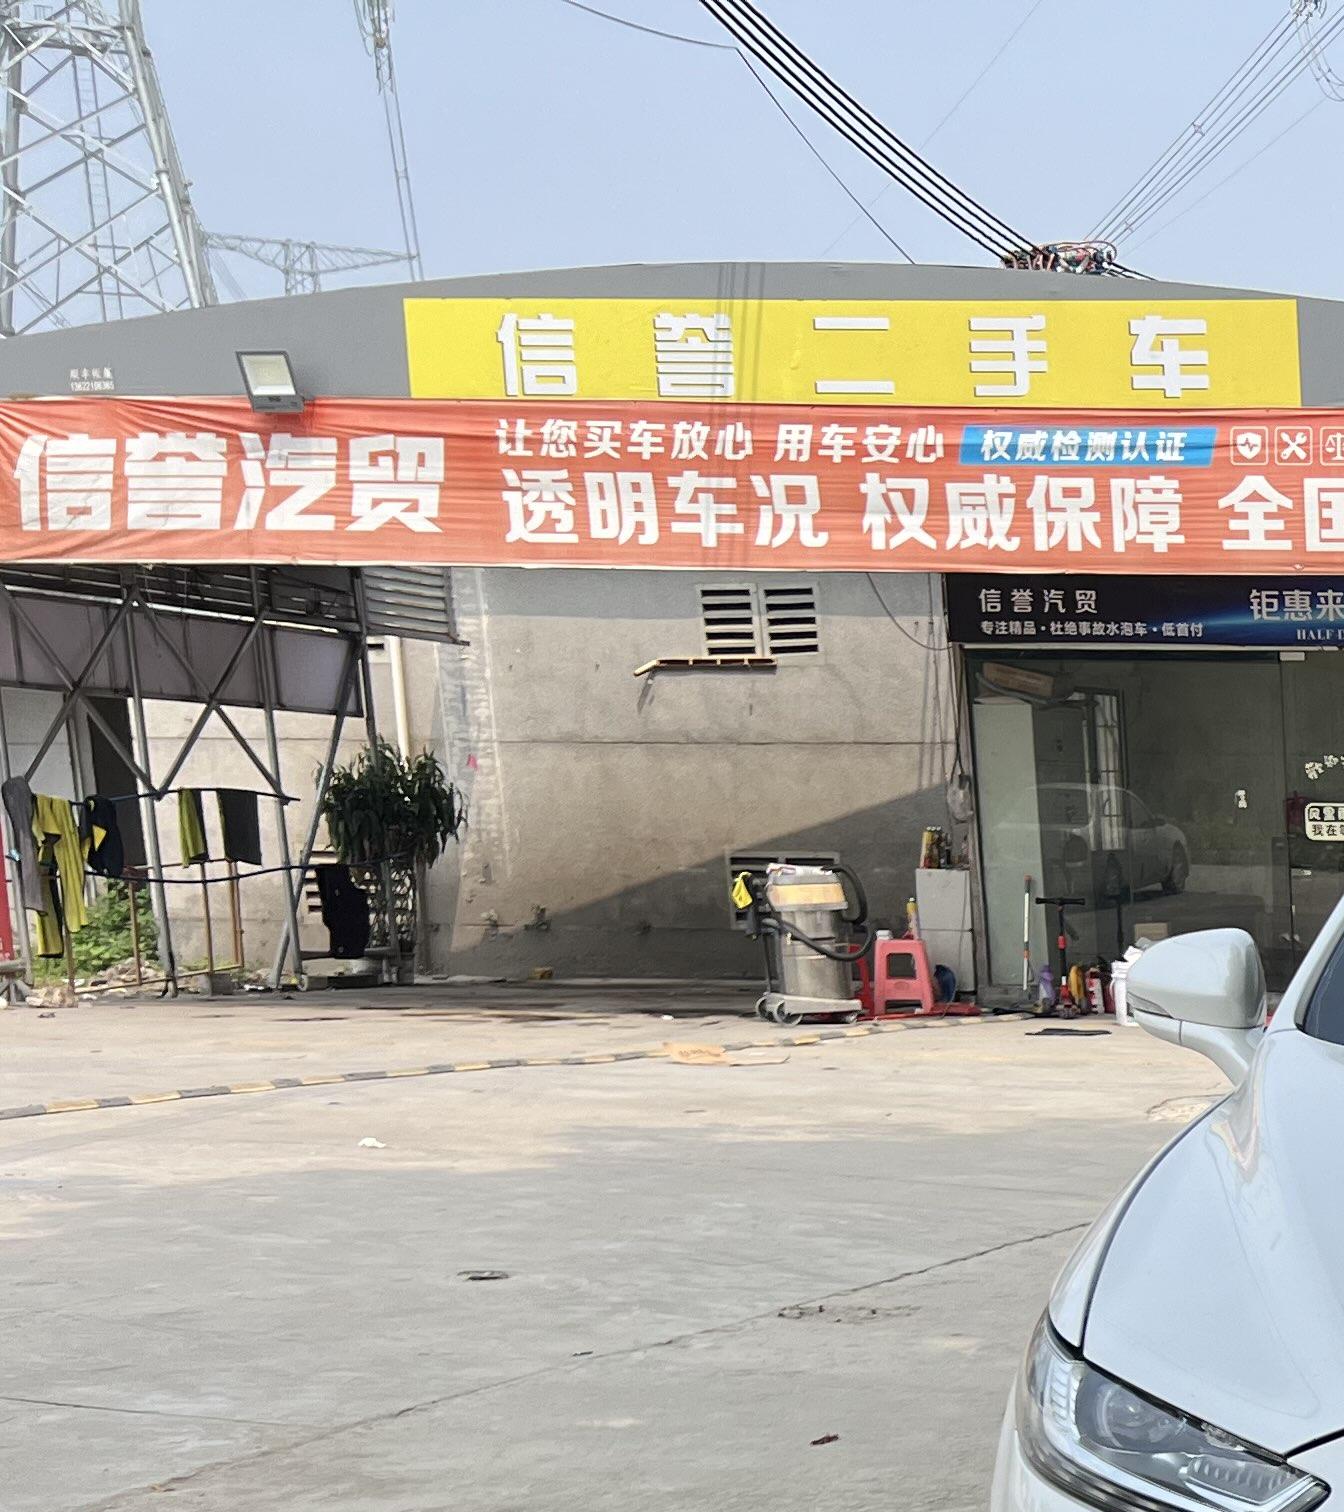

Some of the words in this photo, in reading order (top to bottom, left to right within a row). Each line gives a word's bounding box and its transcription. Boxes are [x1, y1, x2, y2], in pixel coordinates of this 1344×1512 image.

[496, 313, 1210, 398] 信誉二手车
[496, 418, 754, 463] 让您买车放心
[774, 423, 945, 464] 用车安心
[980, 428, 1188, 463] 权威检测认证
[14, 432, 445, 534] 信誉汽贸
[501, 467, 831, 549] 透明车况
[859, 472, 1186, 553] 权威保障
[978, 588, 1099, 615] 信誉汽贸
[1296, 628, 1335, 640] HALF
